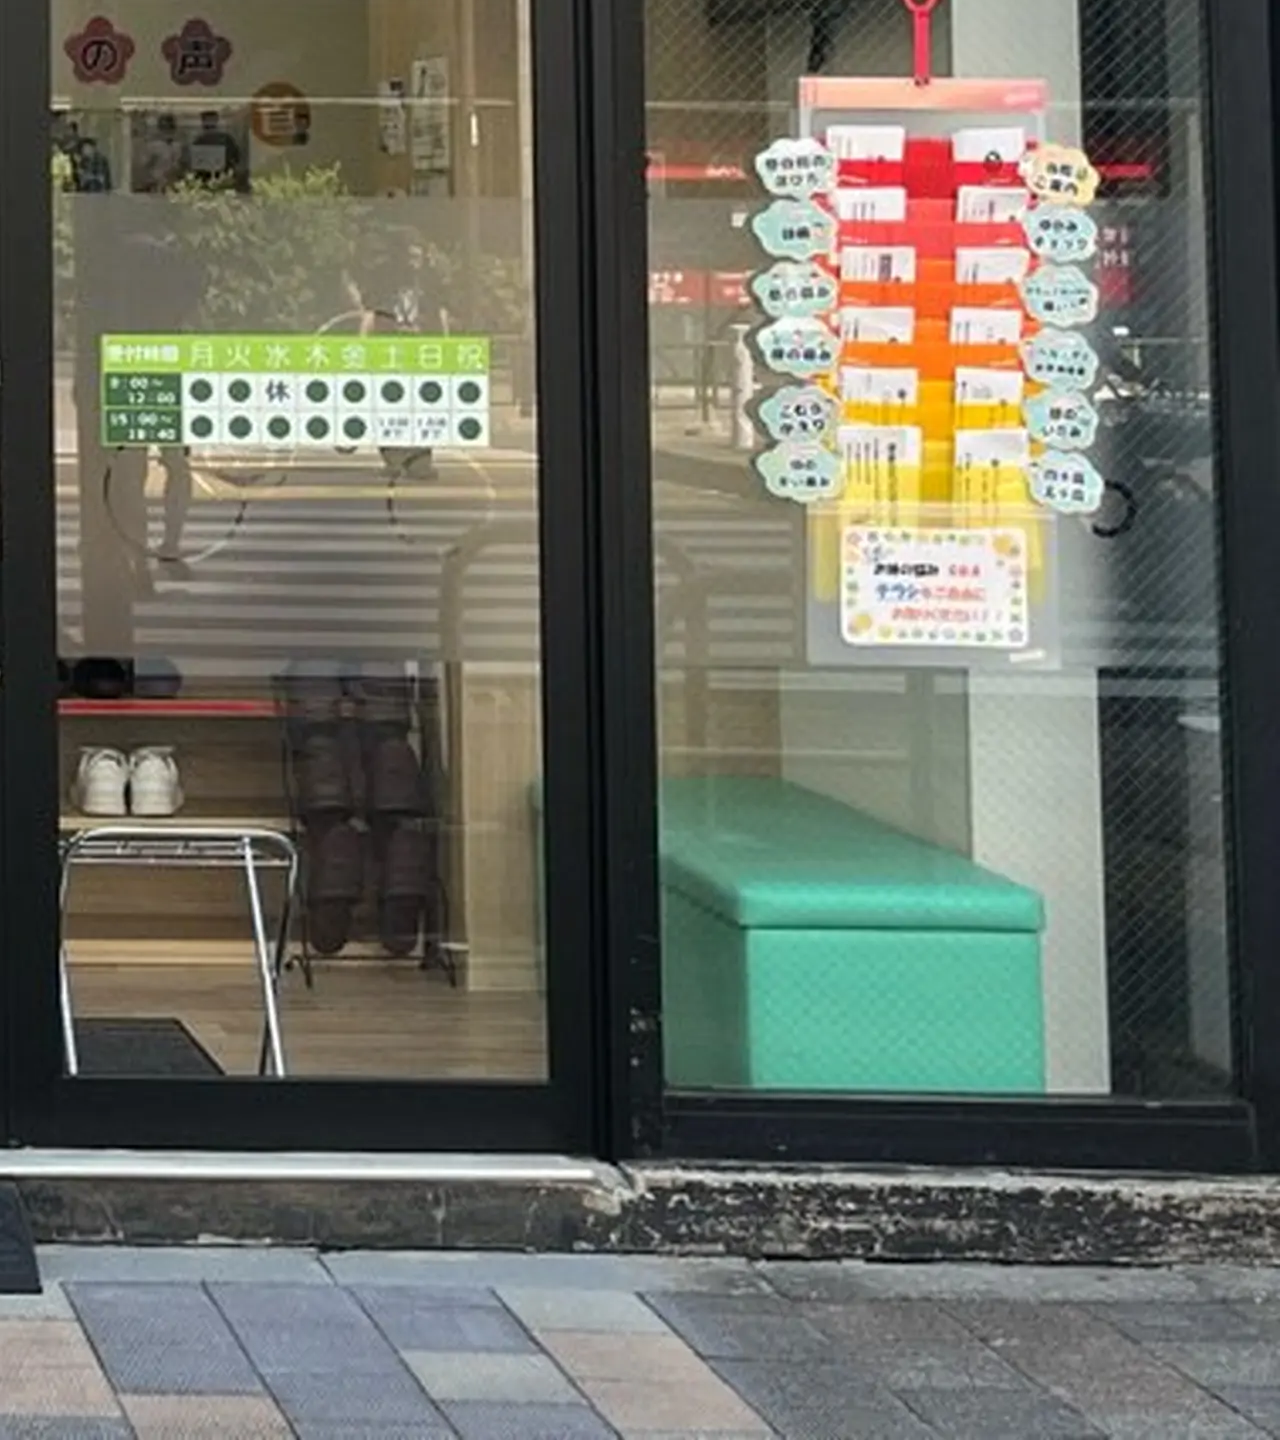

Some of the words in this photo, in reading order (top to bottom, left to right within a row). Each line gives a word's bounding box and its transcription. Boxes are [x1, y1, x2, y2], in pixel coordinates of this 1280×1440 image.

[191, 344, 214, 368] 月
[227, 345, 252, 367] 火
[265, 345, 291, 368] 水
[305, 345, 330, 367] 木
[342, 344, 368, 367] 金
[380, 345, 404, 367] 土
[418, 345, 443, 368] 日
[458, 345, 484, 368] 祝
[265, 379, 292, 403] 休
